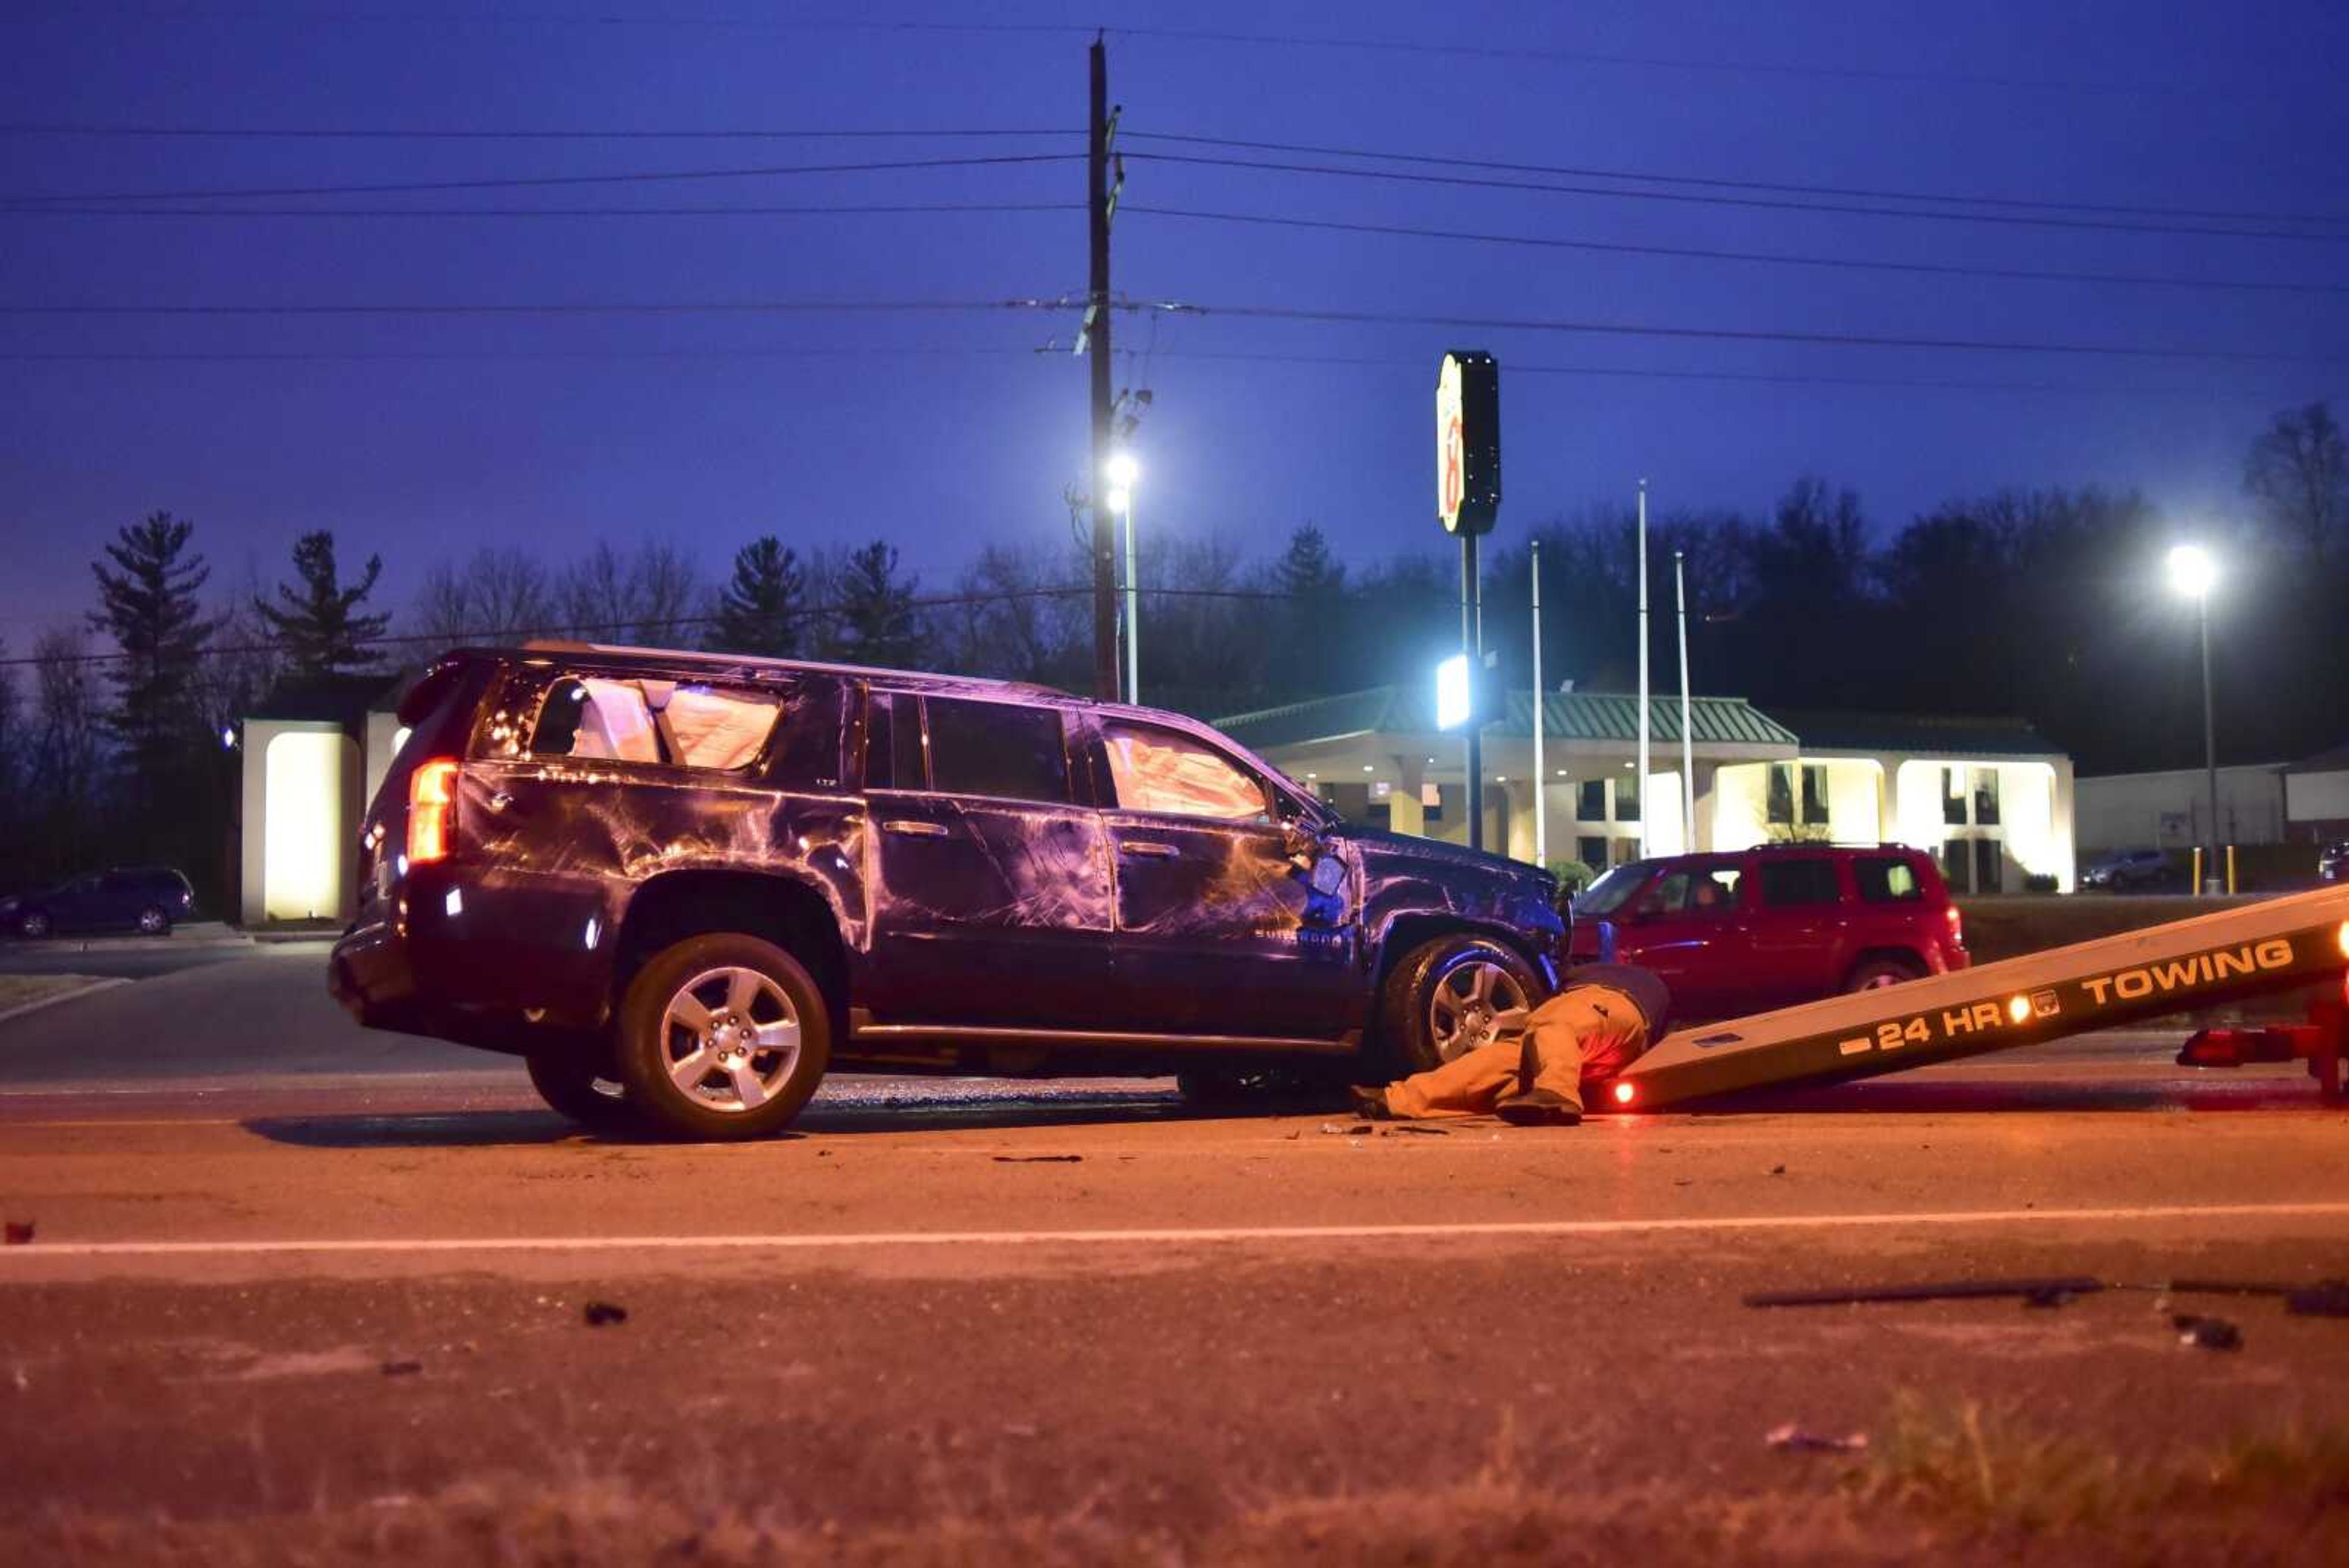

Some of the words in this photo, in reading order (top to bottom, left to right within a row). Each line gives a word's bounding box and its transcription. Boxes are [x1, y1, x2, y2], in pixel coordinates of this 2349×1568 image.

[1877, 1018, 1931, 1050] 24
[1942, 1003, 2003, 1037] HR
[2081, 939, 2293, 1005] TOWING
